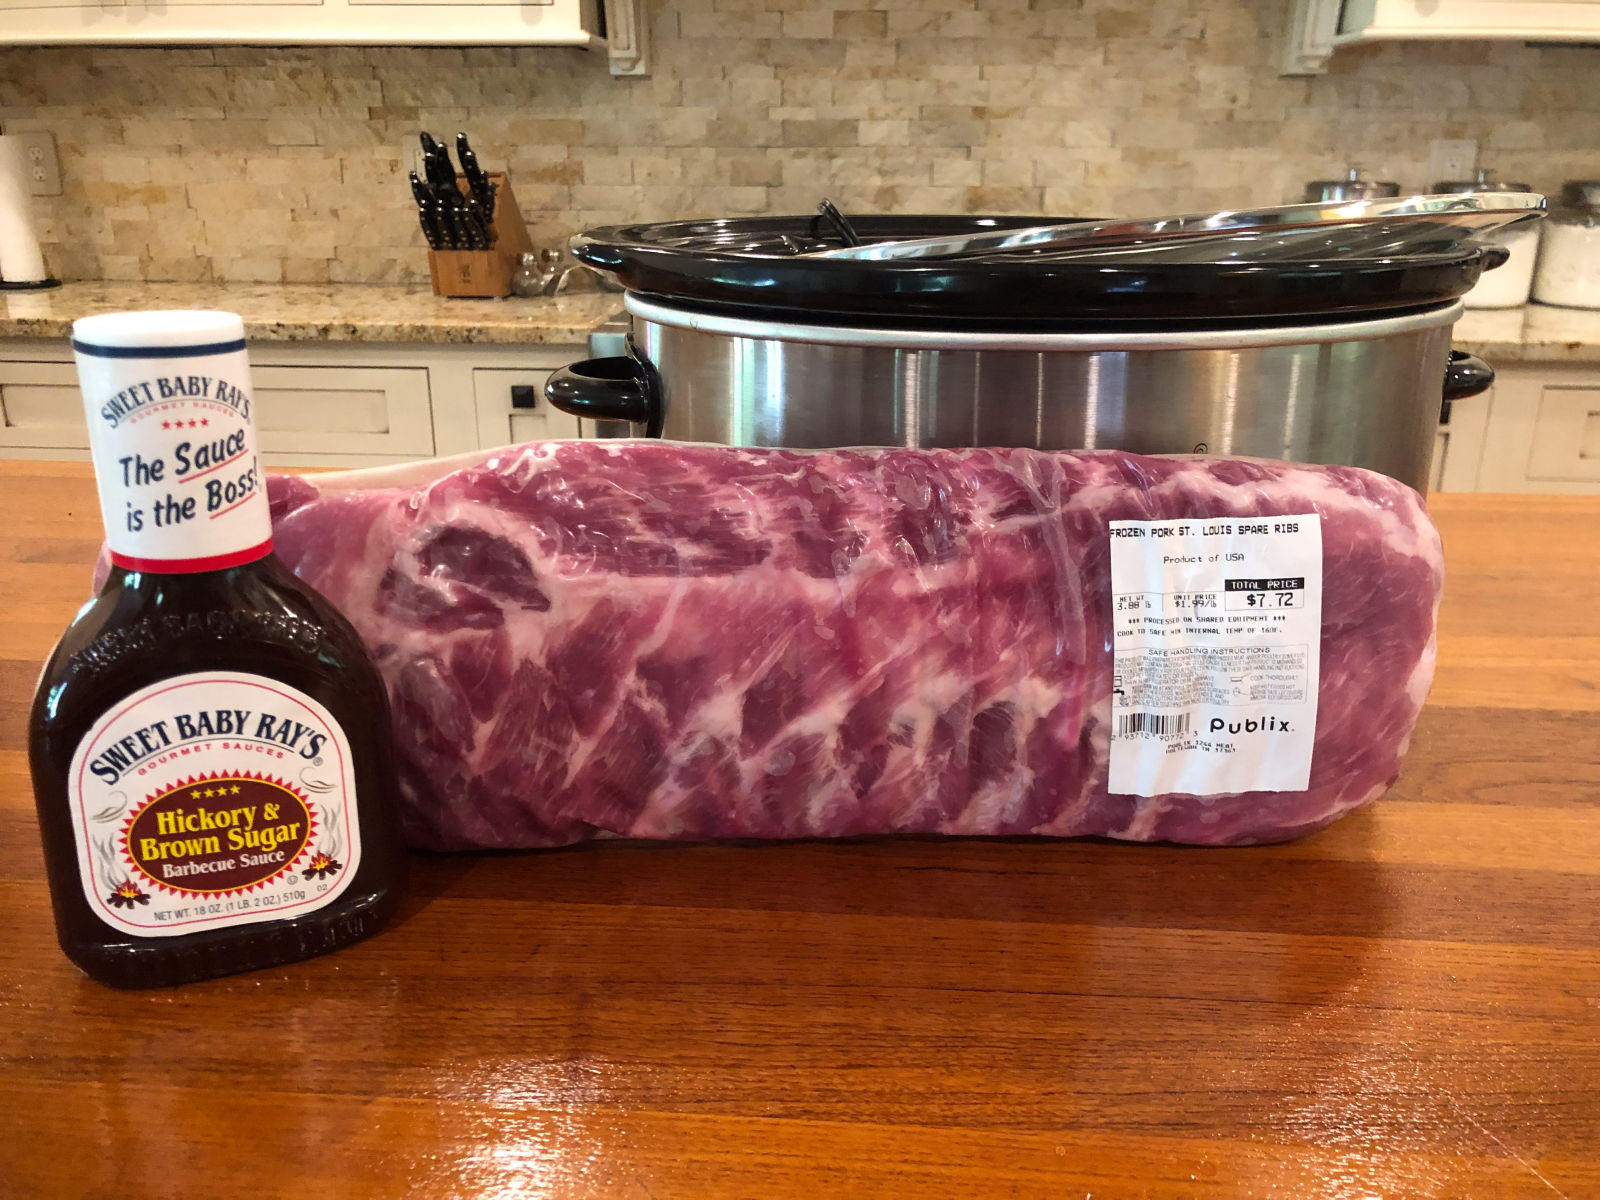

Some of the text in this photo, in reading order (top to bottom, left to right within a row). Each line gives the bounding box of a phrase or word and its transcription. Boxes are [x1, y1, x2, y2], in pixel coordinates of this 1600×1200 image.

[101, 378, 155, 429] SWEET
[156, 375, 212, 399] BABY
[118, 428, 245, 488] The Sauce
[126, 455, 258, 532] is the Boss!
[1110, 523, 1299, 538] FROZEN PORK ST. LOUIS SPARE RIBS
[1163, 553, 1245, 565] Product of USA
[1231, 580, 1298, 590] TOTAL PRICE
[1175, 600, 1217, 609] $1.99/lb
[1246, 592, 1294, 608] $7.72
[1144, 616, 1180, 626] PROCESSED
[1228, 615, 1268, 623] EQUIPMENT
[1117, 630, 1134, 638] COOK
[1149, 629, 1165, 637] SAFE
[1185, 627, 1220, 635] INTERNAL
[1148, 647, 1270, 657] SAFE HANDLING INSTRUCTIONS
[1210, 716, 1291, 734] Publix
[90, 709, 327, 786] SWEET BABY RAY'S
[137, 742, 284, 776] GOURMET SAUCES
[156, 803, 280, 836] Hickory &
[140, 821, 300, 861] Brown Sugar
[163, 850, 285, 879] Barbecue Sauce
[154, 890, 306, 922] NET WT. 18 OZ. (1 LB. 2 OZ.) 510g
